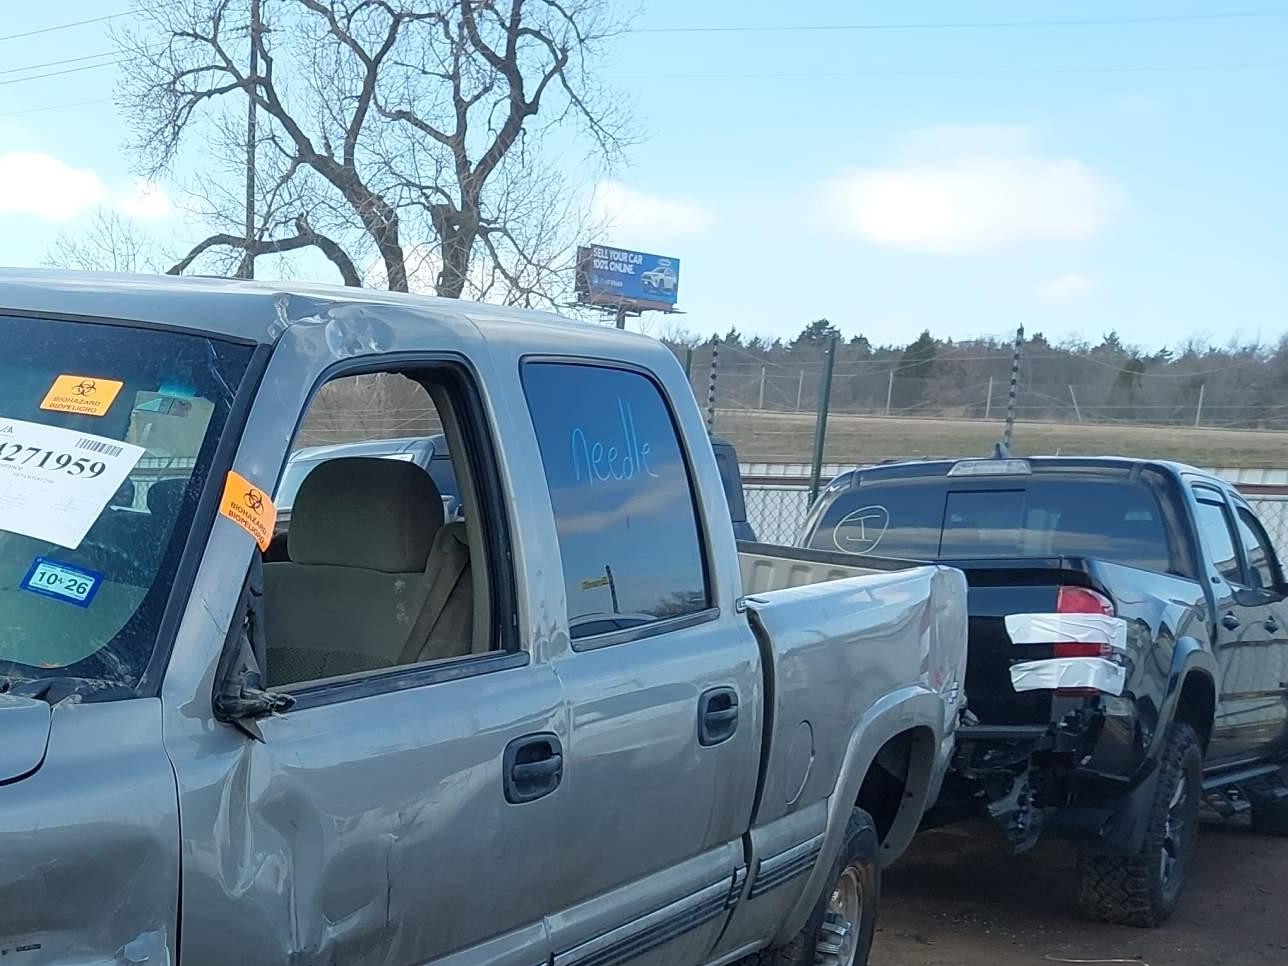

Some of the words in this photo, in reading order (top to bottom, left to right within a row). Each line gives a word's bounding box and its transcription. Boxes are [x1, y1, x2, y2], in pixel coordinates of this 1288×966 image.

[593, 247, 609, 259] SELL
[609, 250, 628, 263] YOUR
[629, 254, 643, 265] CAR
[593, 259, 609, 271] 100%
[49, 402, 97, 413] BIOPELIGRO
[53, 396, 101, 407] BIOHAZARD
[228, 509, 265, 544] BIOPELIGRO
[230, 501, 267, 535] BIOHAZARD
[38, 571, 59, 585] 10
[64, 578, 88, 595] 26
